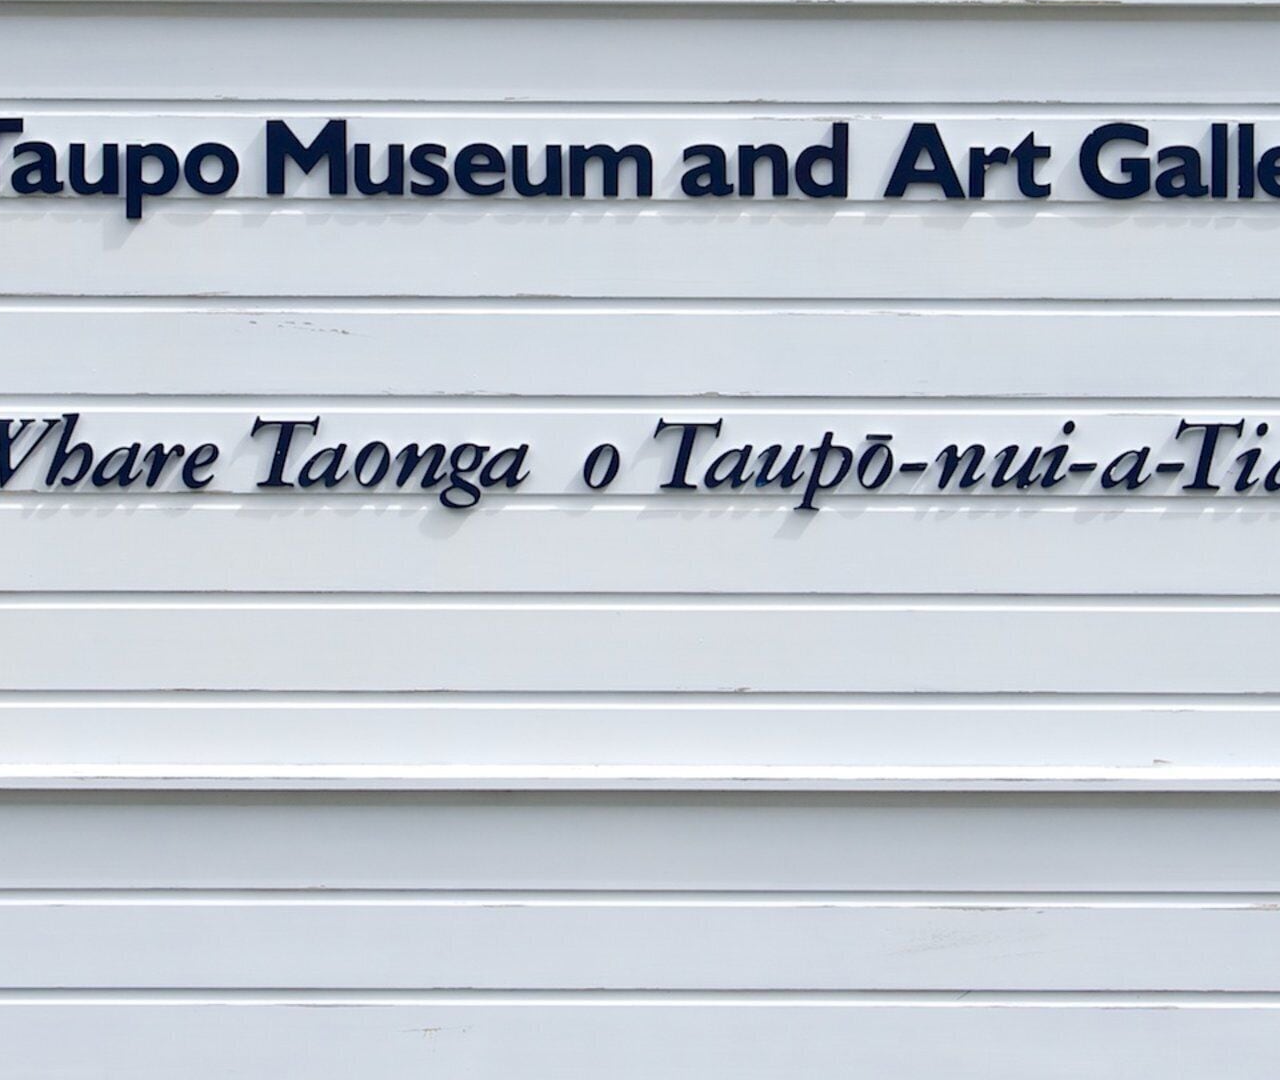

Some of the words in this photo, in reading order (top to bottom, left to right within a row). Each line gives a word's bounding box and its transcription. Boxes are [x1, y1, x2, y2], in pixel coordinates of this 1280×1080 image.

[266, 119, 653, 201] Museum
[680, 121, 849, 201] and
[883, 122, 1052, 202] Art
[250, 415, 530, 513] Taonga
[583, 443, 620, 491] o
